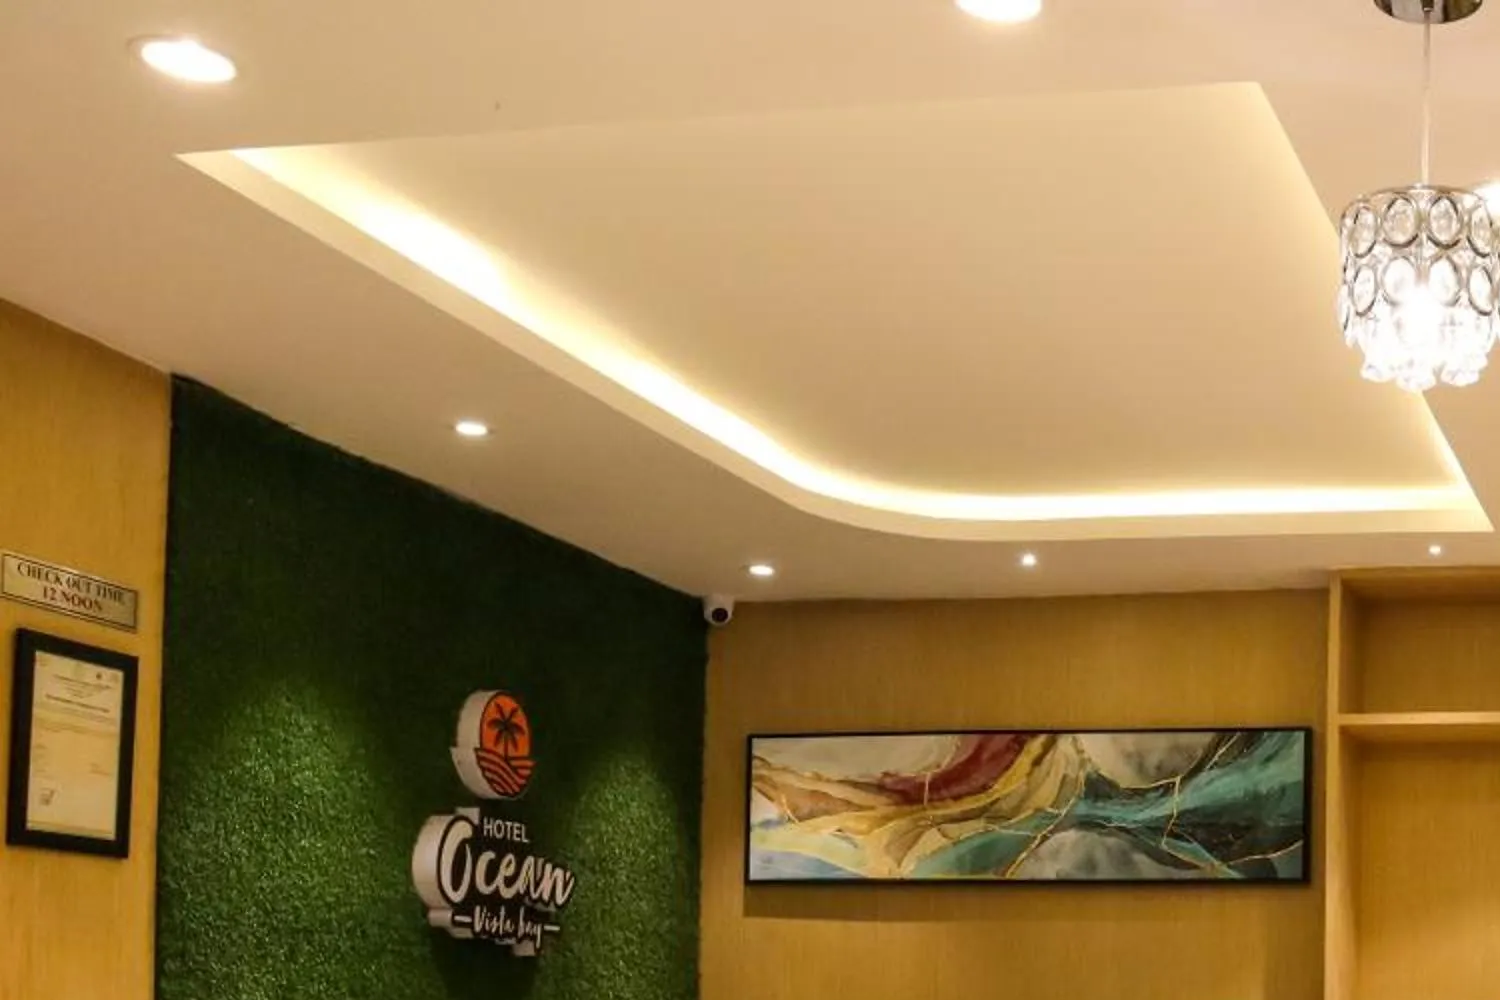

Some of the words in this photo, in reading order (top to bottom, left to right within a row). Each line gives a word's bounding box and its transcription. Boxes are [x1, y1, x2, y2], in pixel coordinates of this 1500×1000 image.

[17, 561, 63, 587] CHECK
[66, 576, 91, 594] OUT
[95, 582, 126, 605] TIME
[43, 586, 57, 600] 12
[61, 590, 103, 612] NOON
[482, 818, 530, 844] HOTEL
[440, 818, 575, 906] Ocean
[473, 904, 515, 936] Vista
[517, 905, 543, 949] bay
